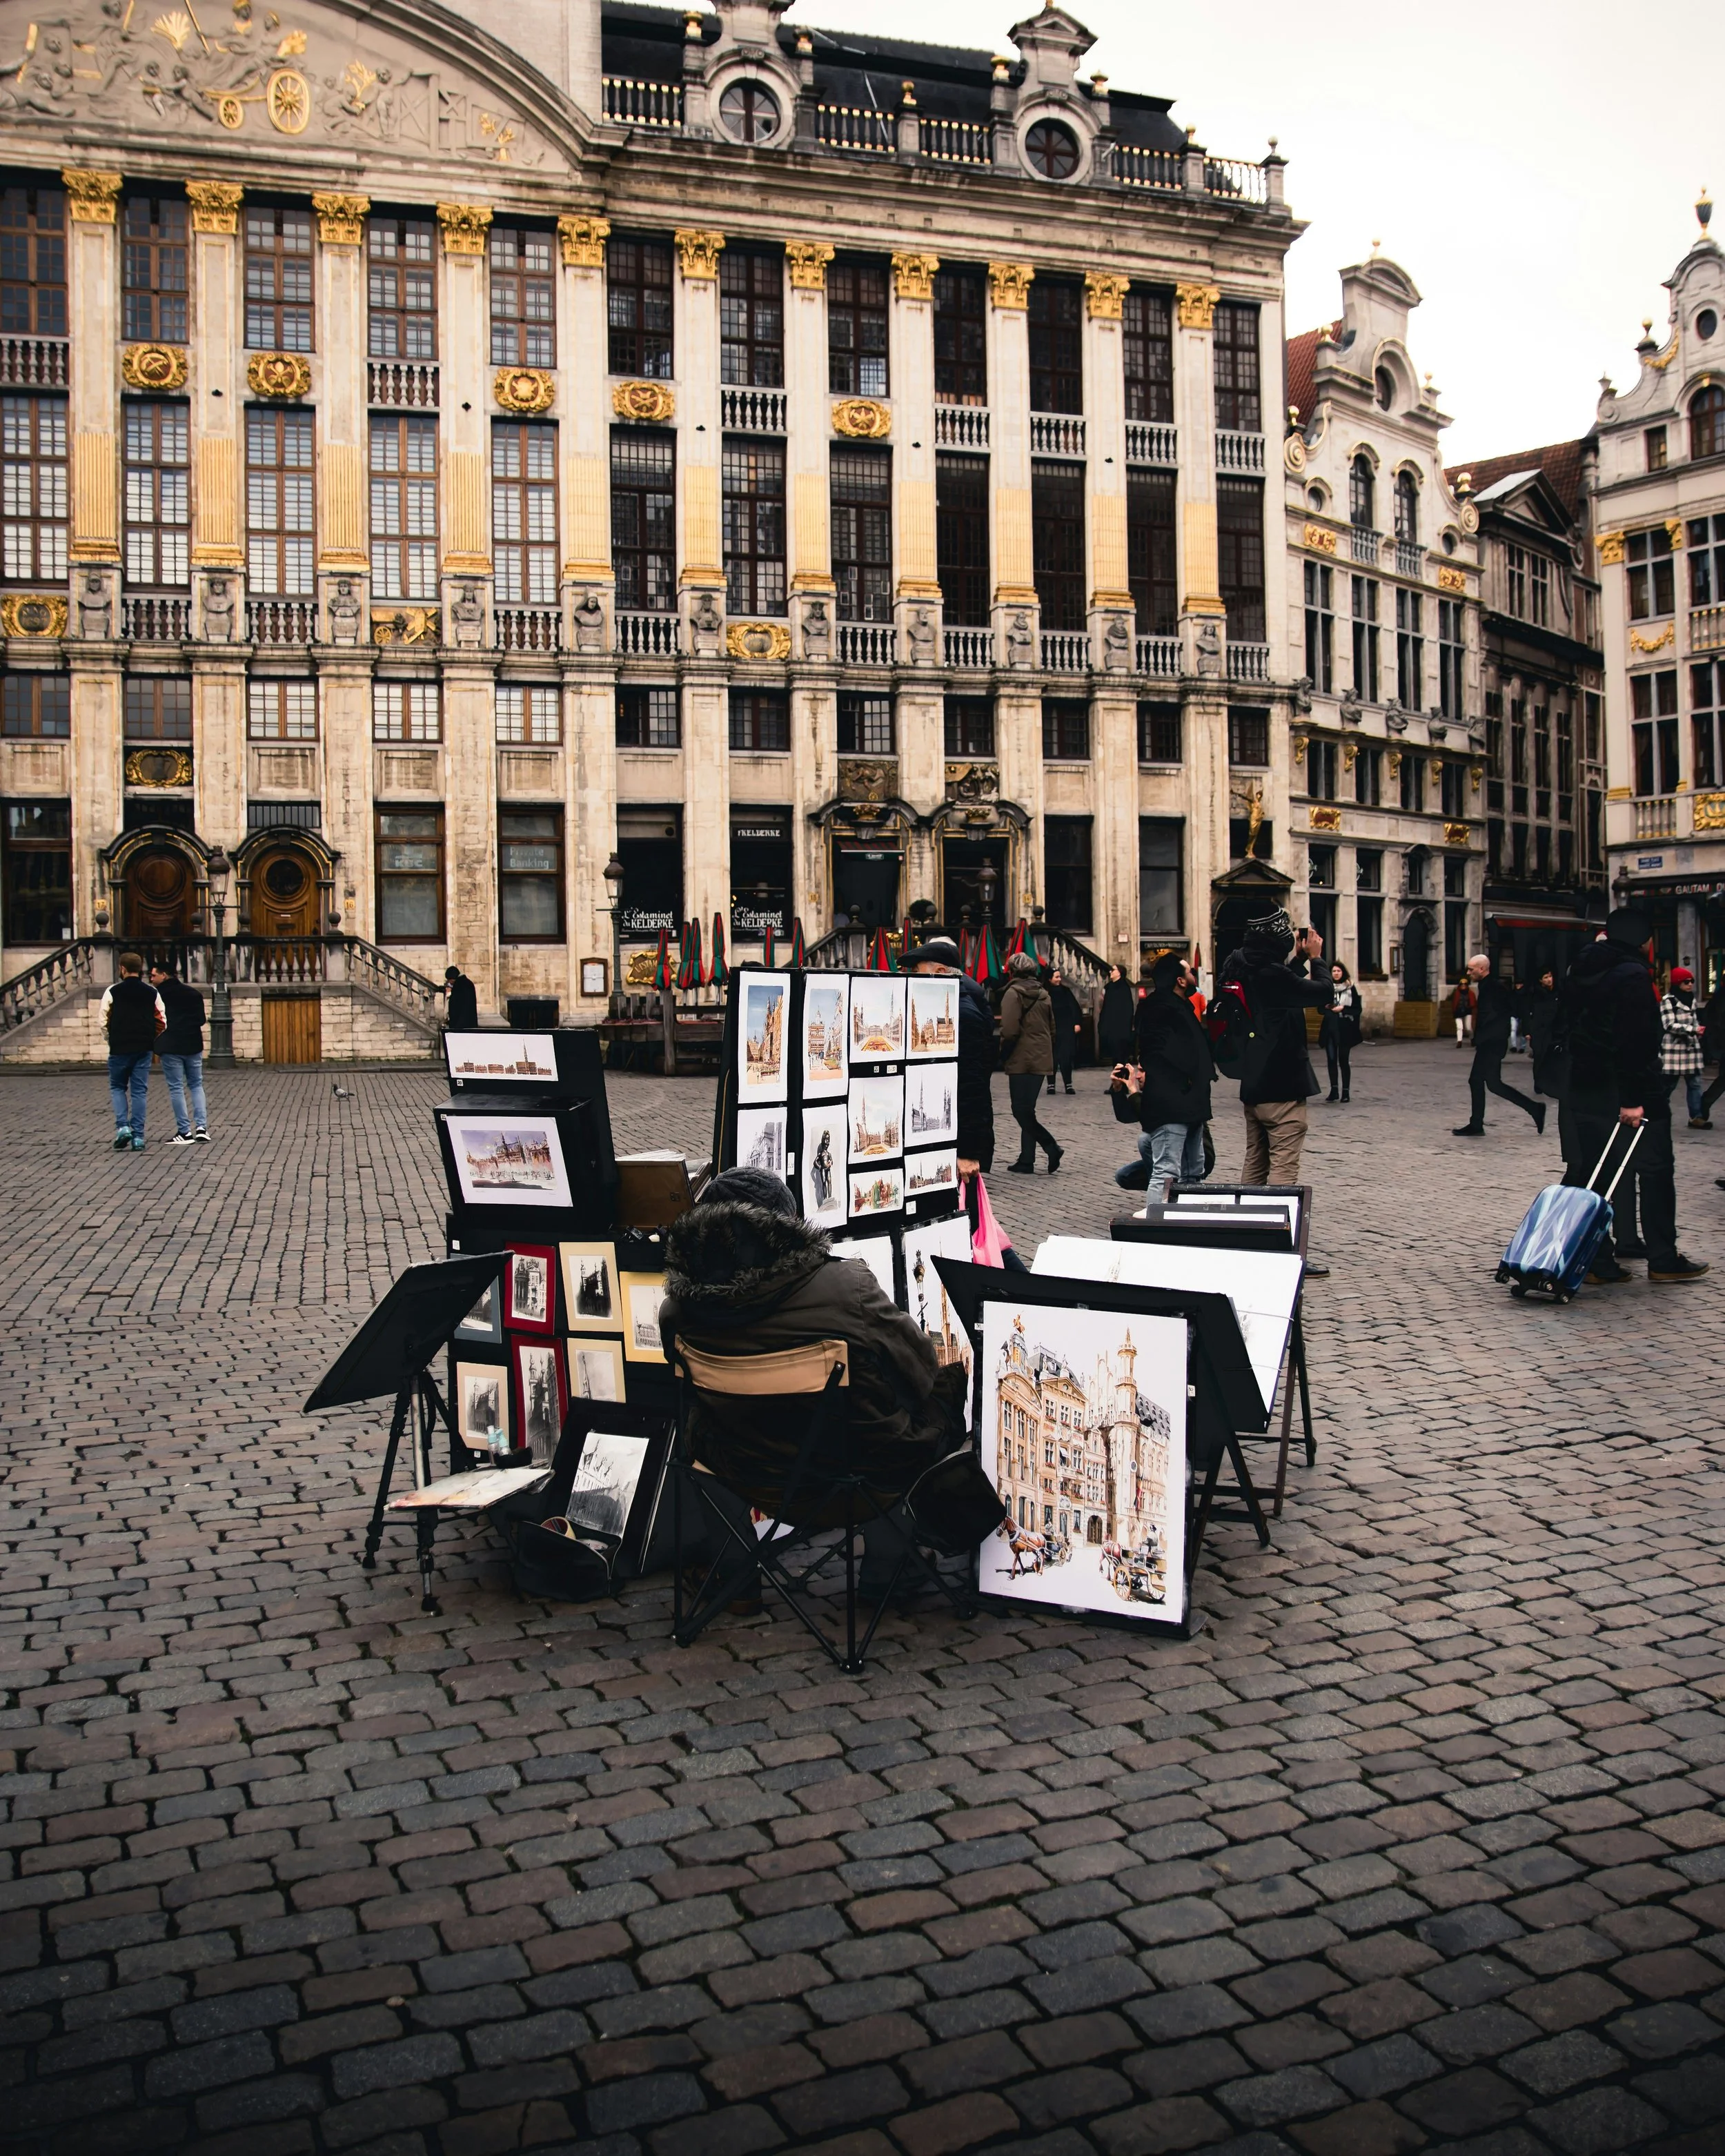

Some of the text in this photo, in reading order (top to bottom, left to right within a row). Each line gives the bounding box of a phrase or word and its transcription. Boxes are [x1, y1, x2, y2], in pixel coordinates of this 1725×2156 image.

[510, 847, 544, 856] Private
[510, 858, 549, 869] Banking
[1675, 883, 1710, 895] GAUTAM
[621, 907, 673, 919] L'Estaminet
[731, 906, 782, 918] L'Estaminet
[631, 918, 674, 929] KELDERKE
